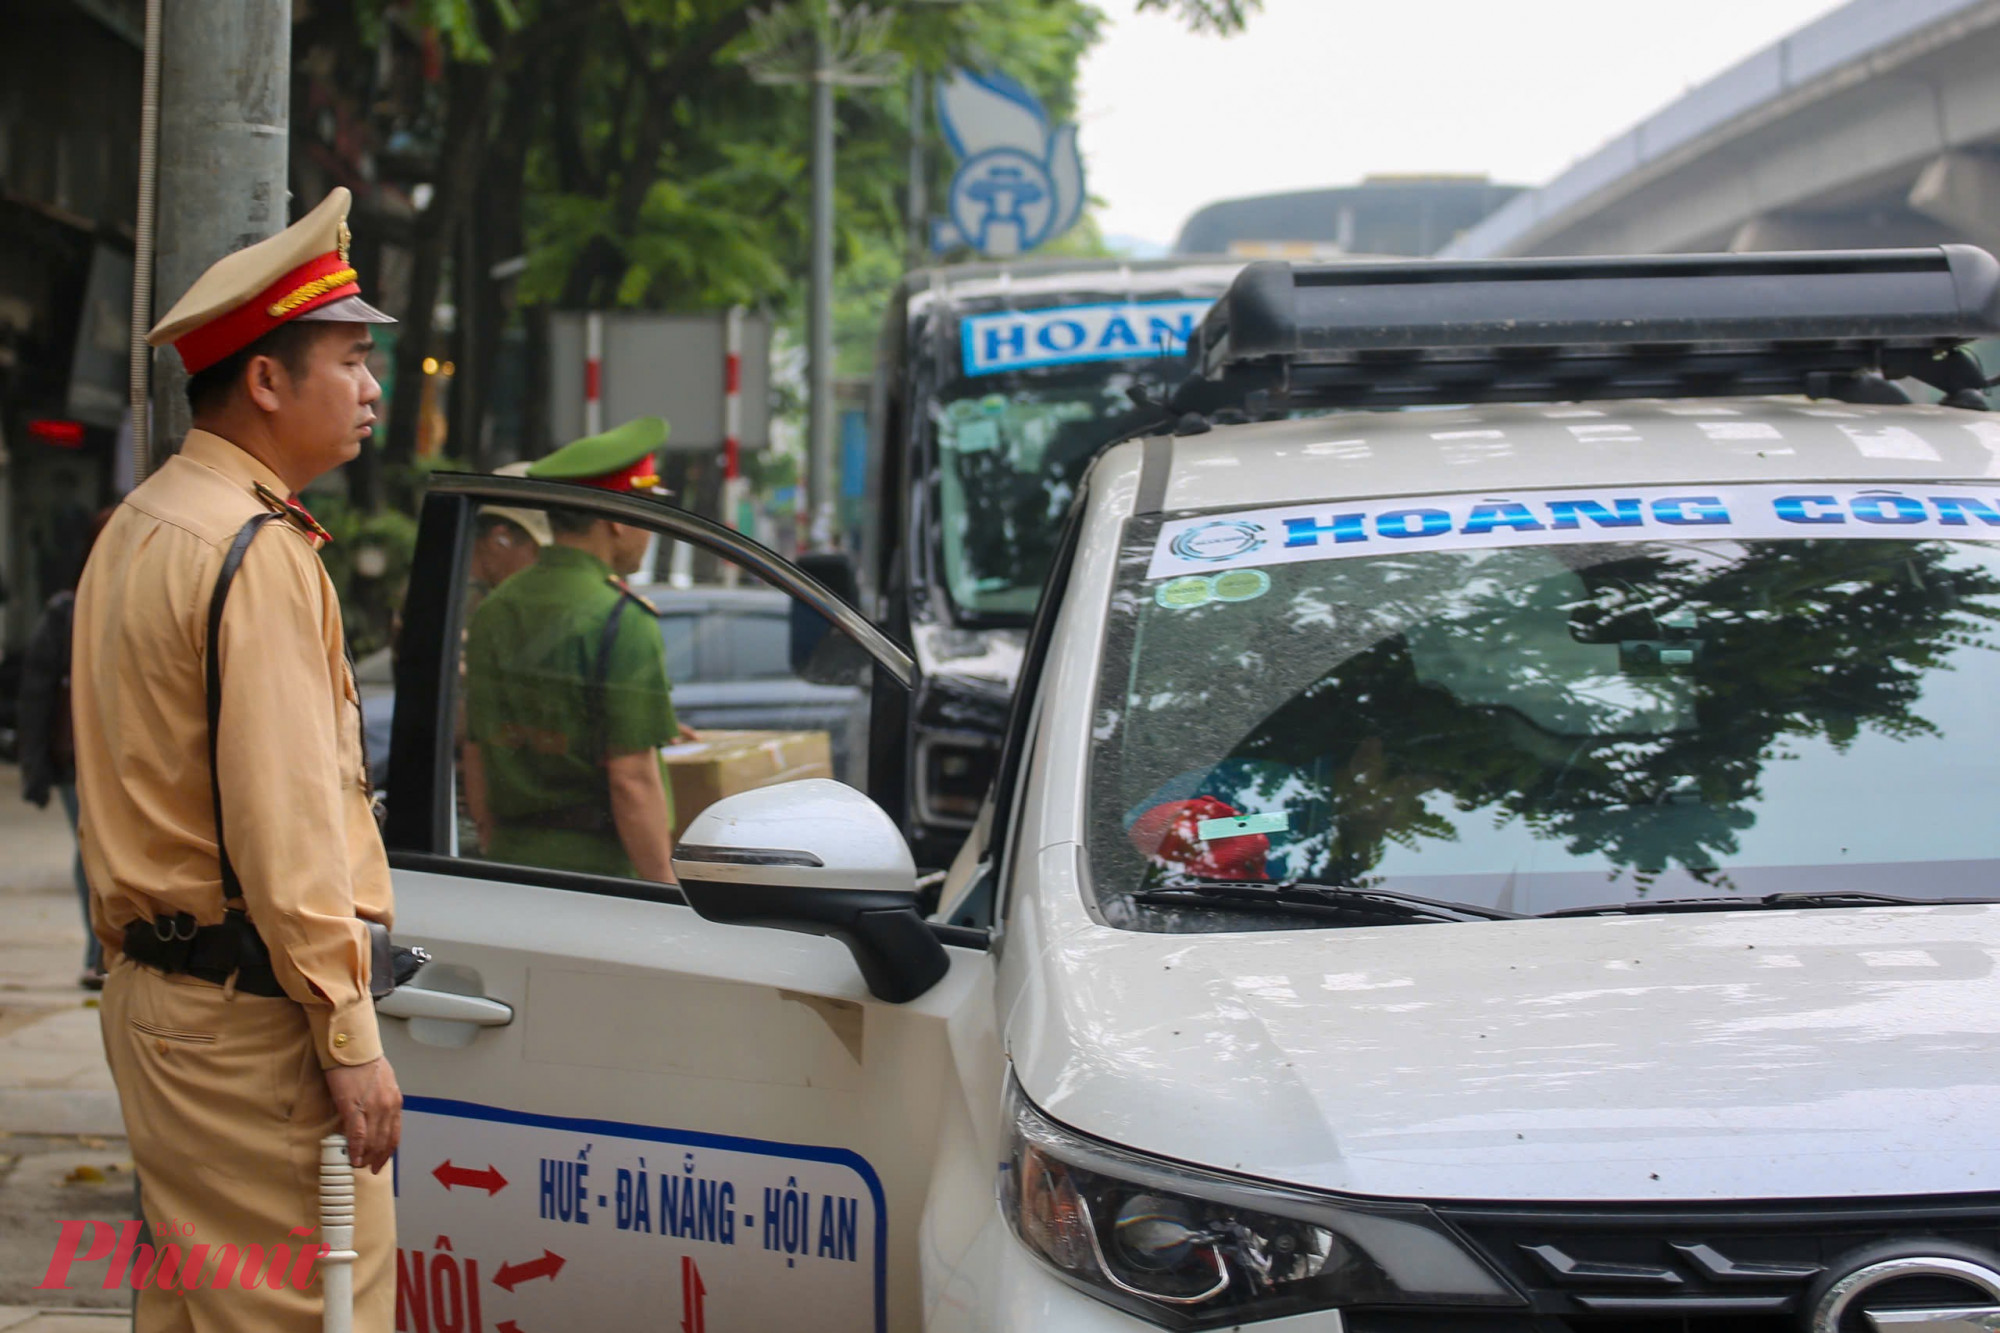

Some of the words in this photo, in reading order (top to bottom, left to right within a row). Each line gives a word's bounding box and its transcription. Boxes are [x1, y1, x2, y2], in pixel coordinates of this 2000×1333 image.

[1282, 496, 1732, 548] HOÀNG
[540, 1143, 592, 1225] HUẾ
[616, 1156, 652, 1234] ĐÀ
[764, 1175, 809, 1268] HỘI
[818, 1194, 858, 1263] AN
